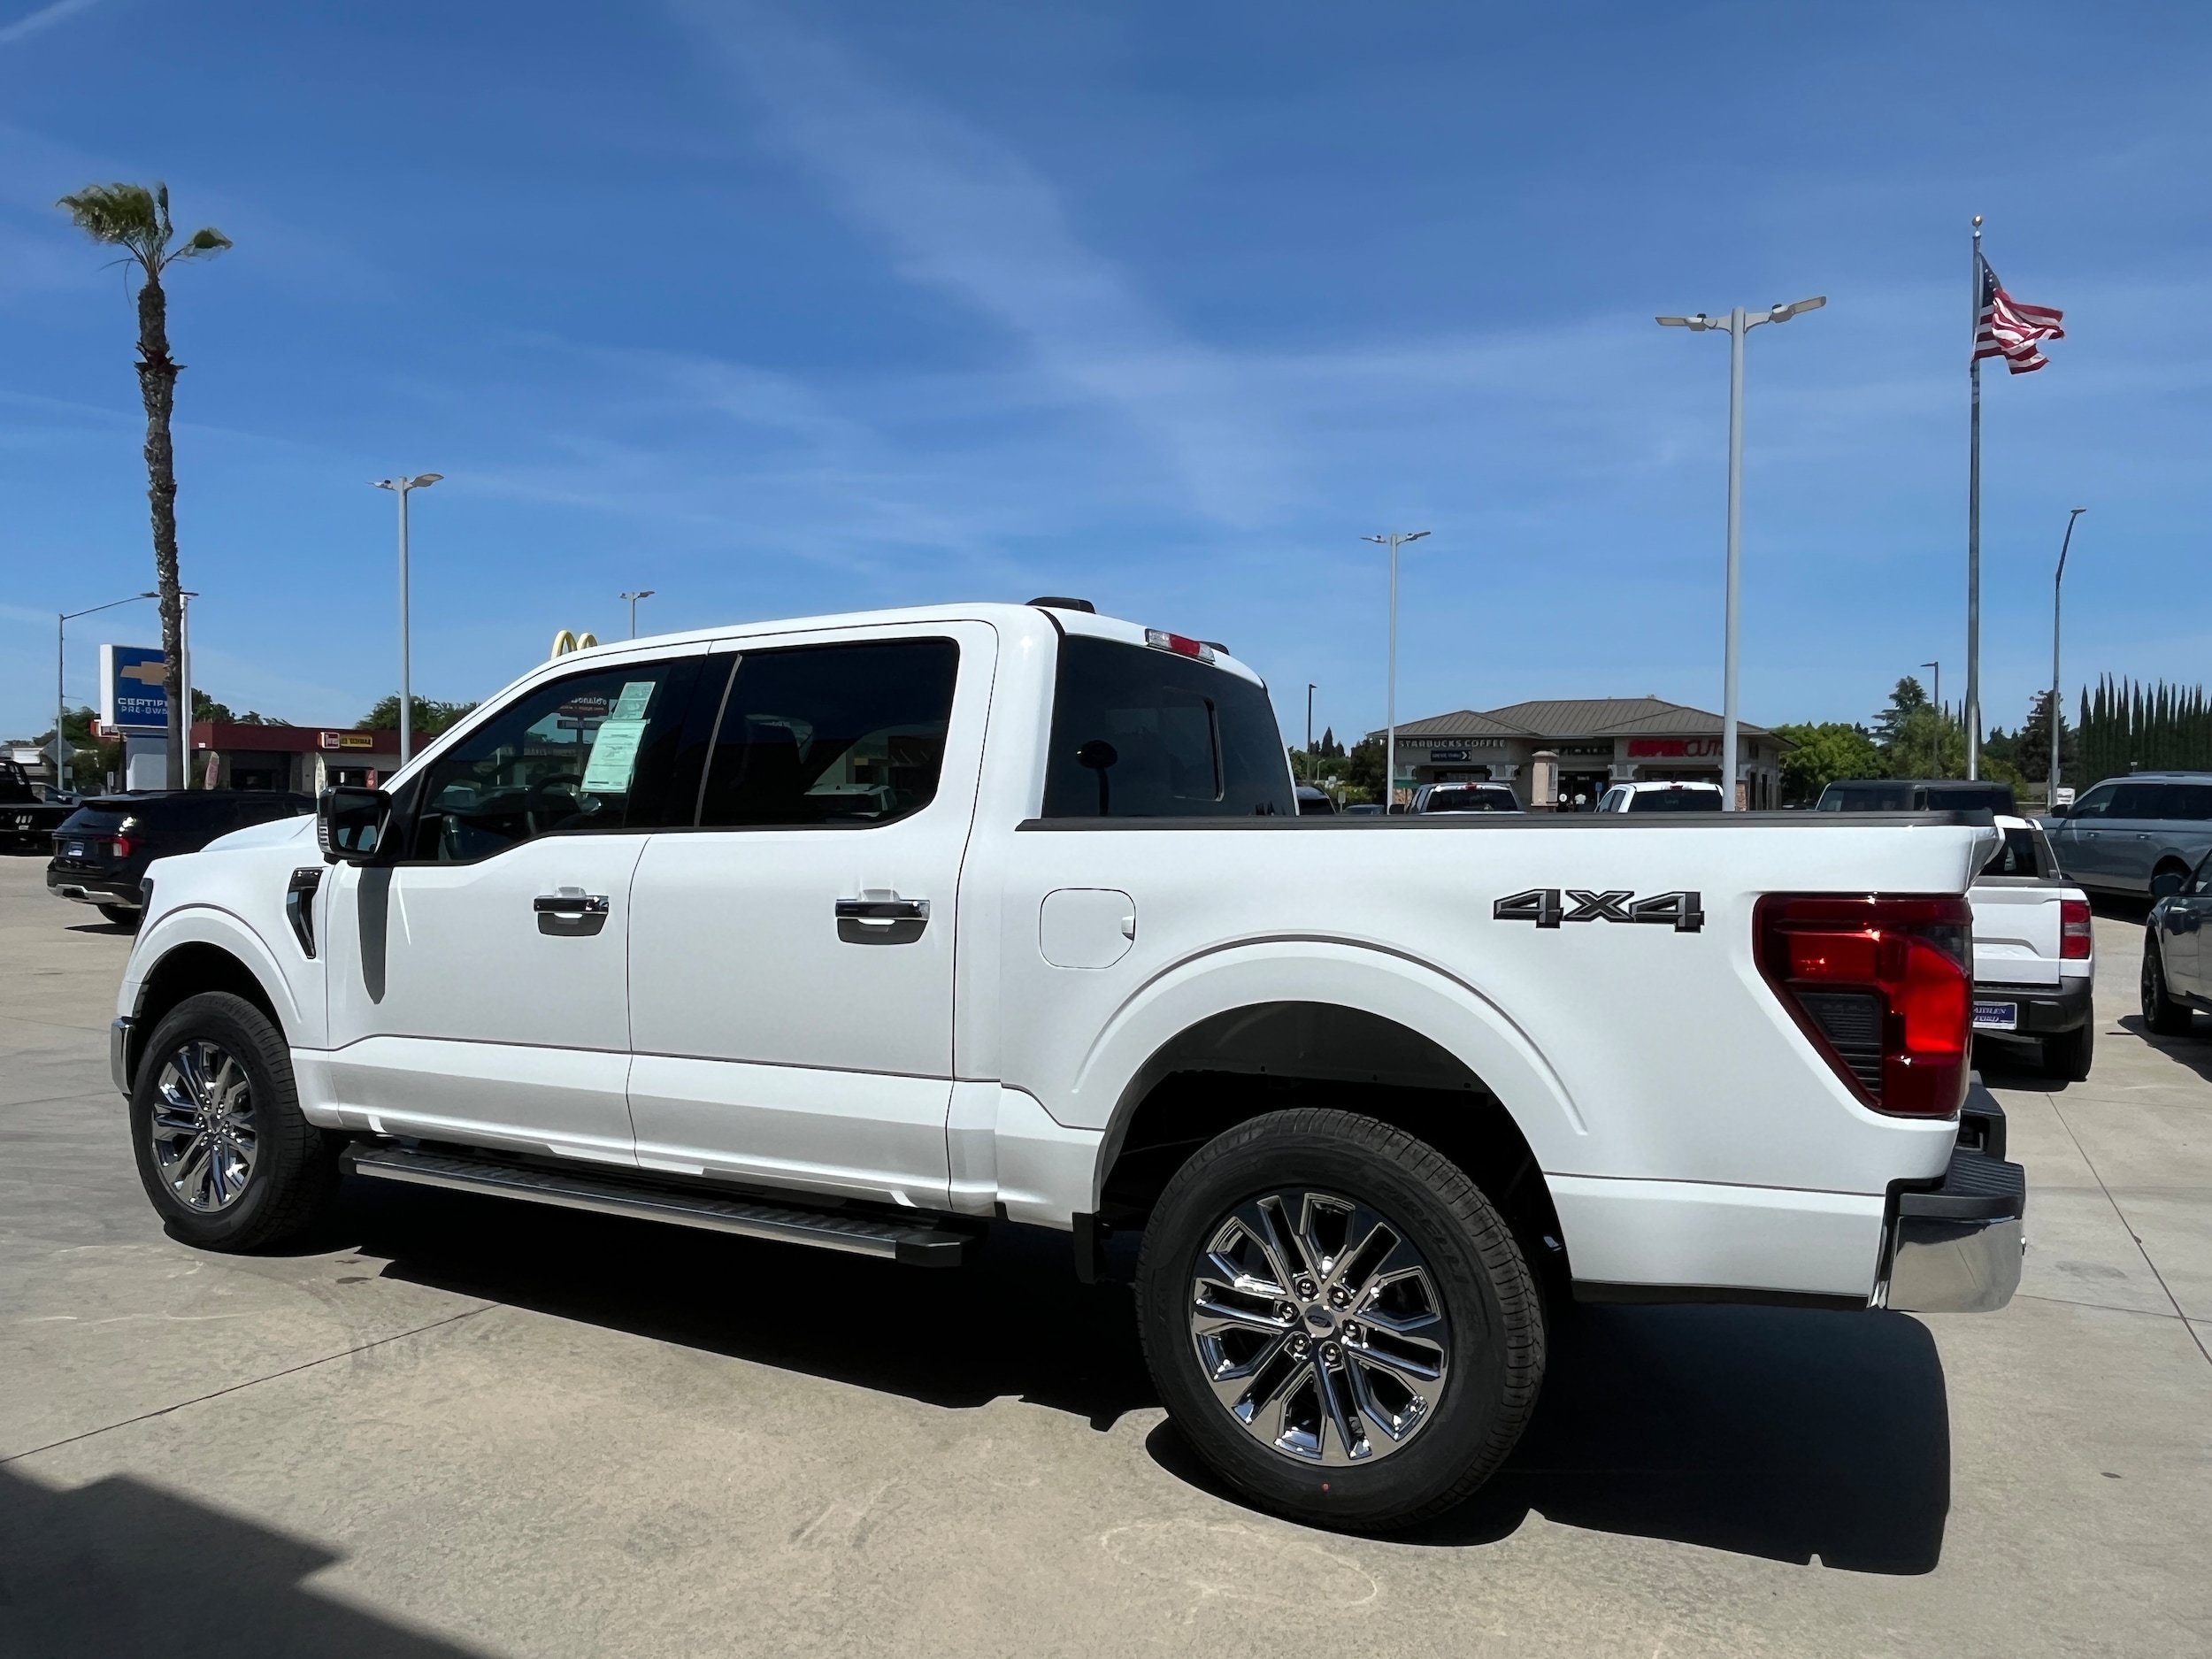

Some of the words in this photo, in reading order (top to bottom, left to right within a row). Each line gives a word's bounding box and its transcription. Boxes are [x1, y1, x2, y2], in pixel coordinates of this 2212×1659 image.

[118, 697, 167, 707] CERTIFI
[121, 705, 168, 714] PRE-OWN
[1398, 739, 1461, 749] STARBUCKS
[1464, 739, 1505, 748] COFFEE
